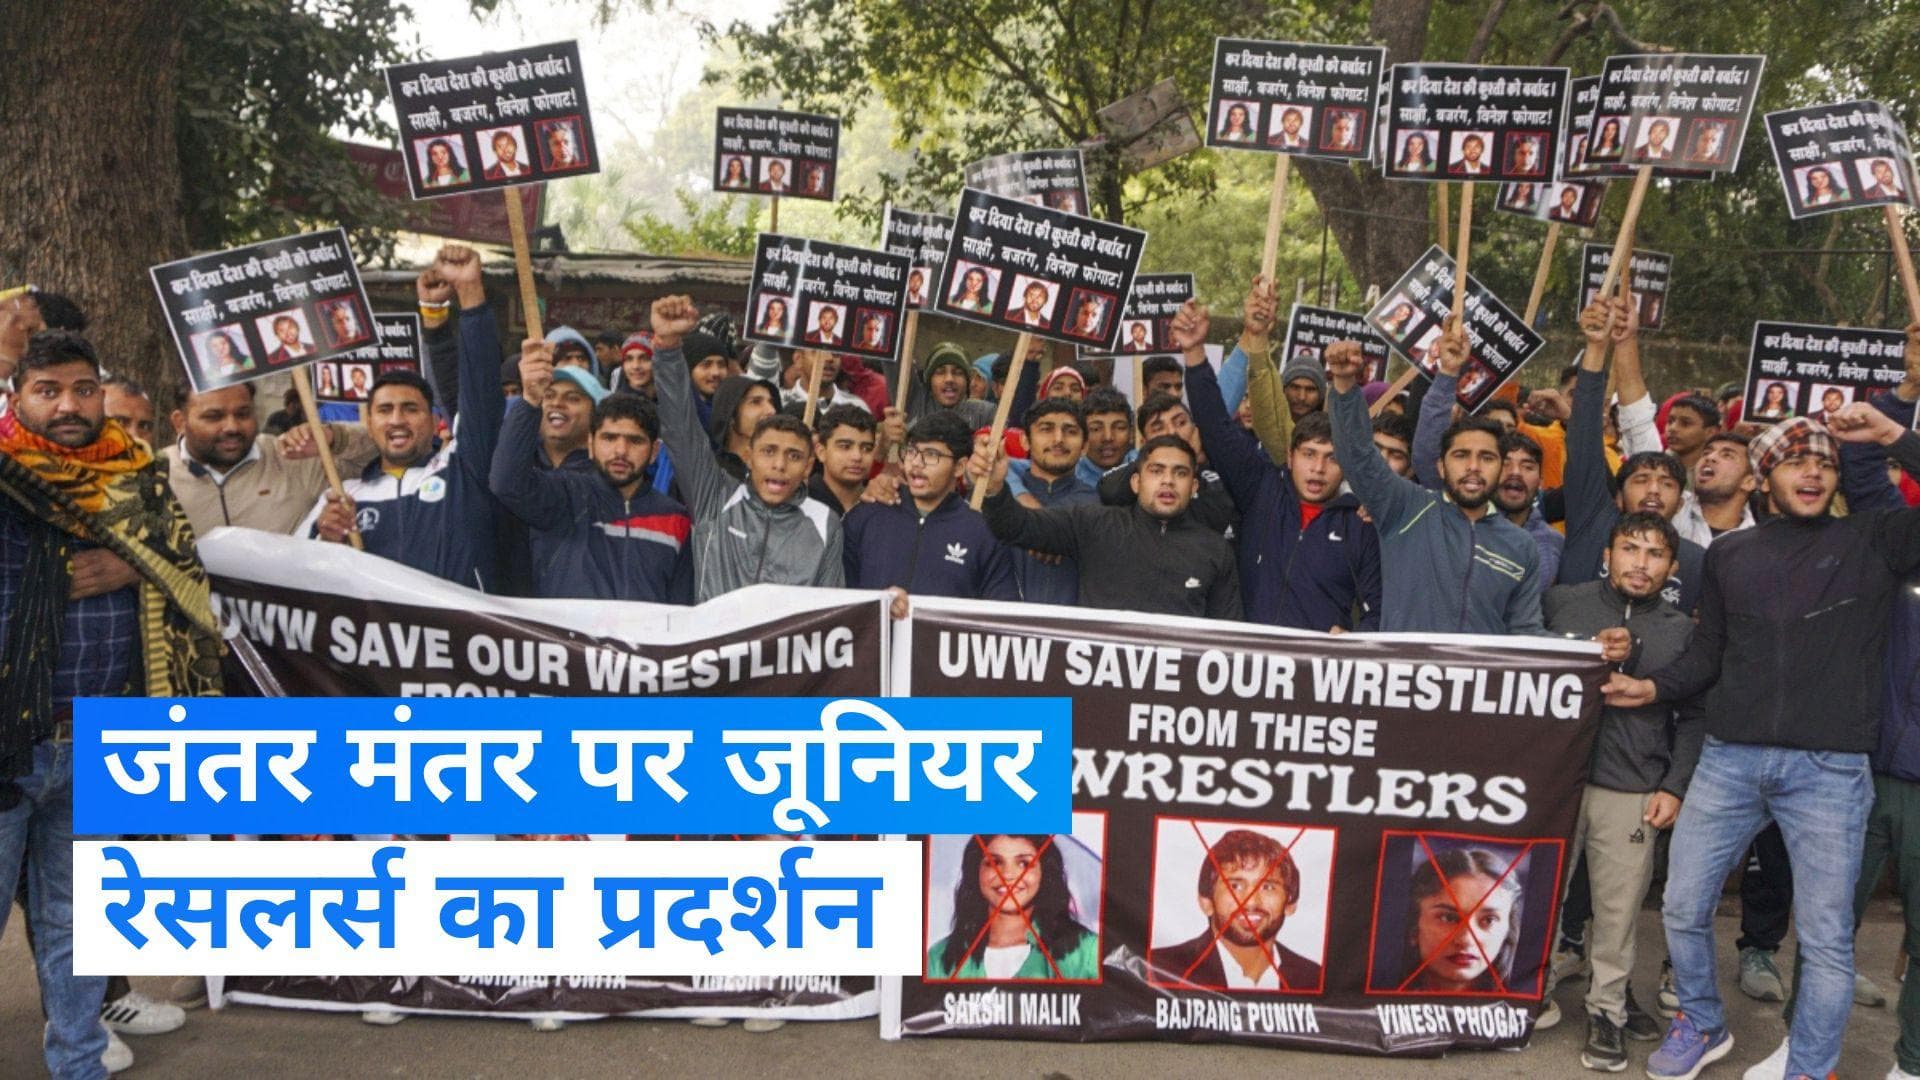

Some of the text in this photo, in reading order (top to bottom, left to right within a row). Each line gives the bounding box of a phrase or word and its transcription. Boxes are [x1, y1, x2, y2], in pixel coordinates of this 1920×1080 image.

[968, 206, 987, 224] कर
[987, 206, 1014, 230] दिया
[1014, 212, 1034, 235] देश
[1034, 219, 1051, 239] की
[1050, 226, 1080, 248] कुश्ती
[1080, 230, 1096, 250] को
[1045, 252, 1078, 278] विनेश
[329, 614, 453, 669] SAVE
[466, 634, 569, 687] OUR
[585, 626, 854, 694] WRESTLING
[938, 631, 1584, 719] UWW SAVE OUR WRESTLING
[1128, 703, 1378, 757] FROM THESE
[943, 991, 1082, 1026] SAKSHI MALIK
[1155, 997, 1321, 1034] BAJRANG PUNIYA
[1376, 1004, 1529, 1039] VINESH PHOGAT
